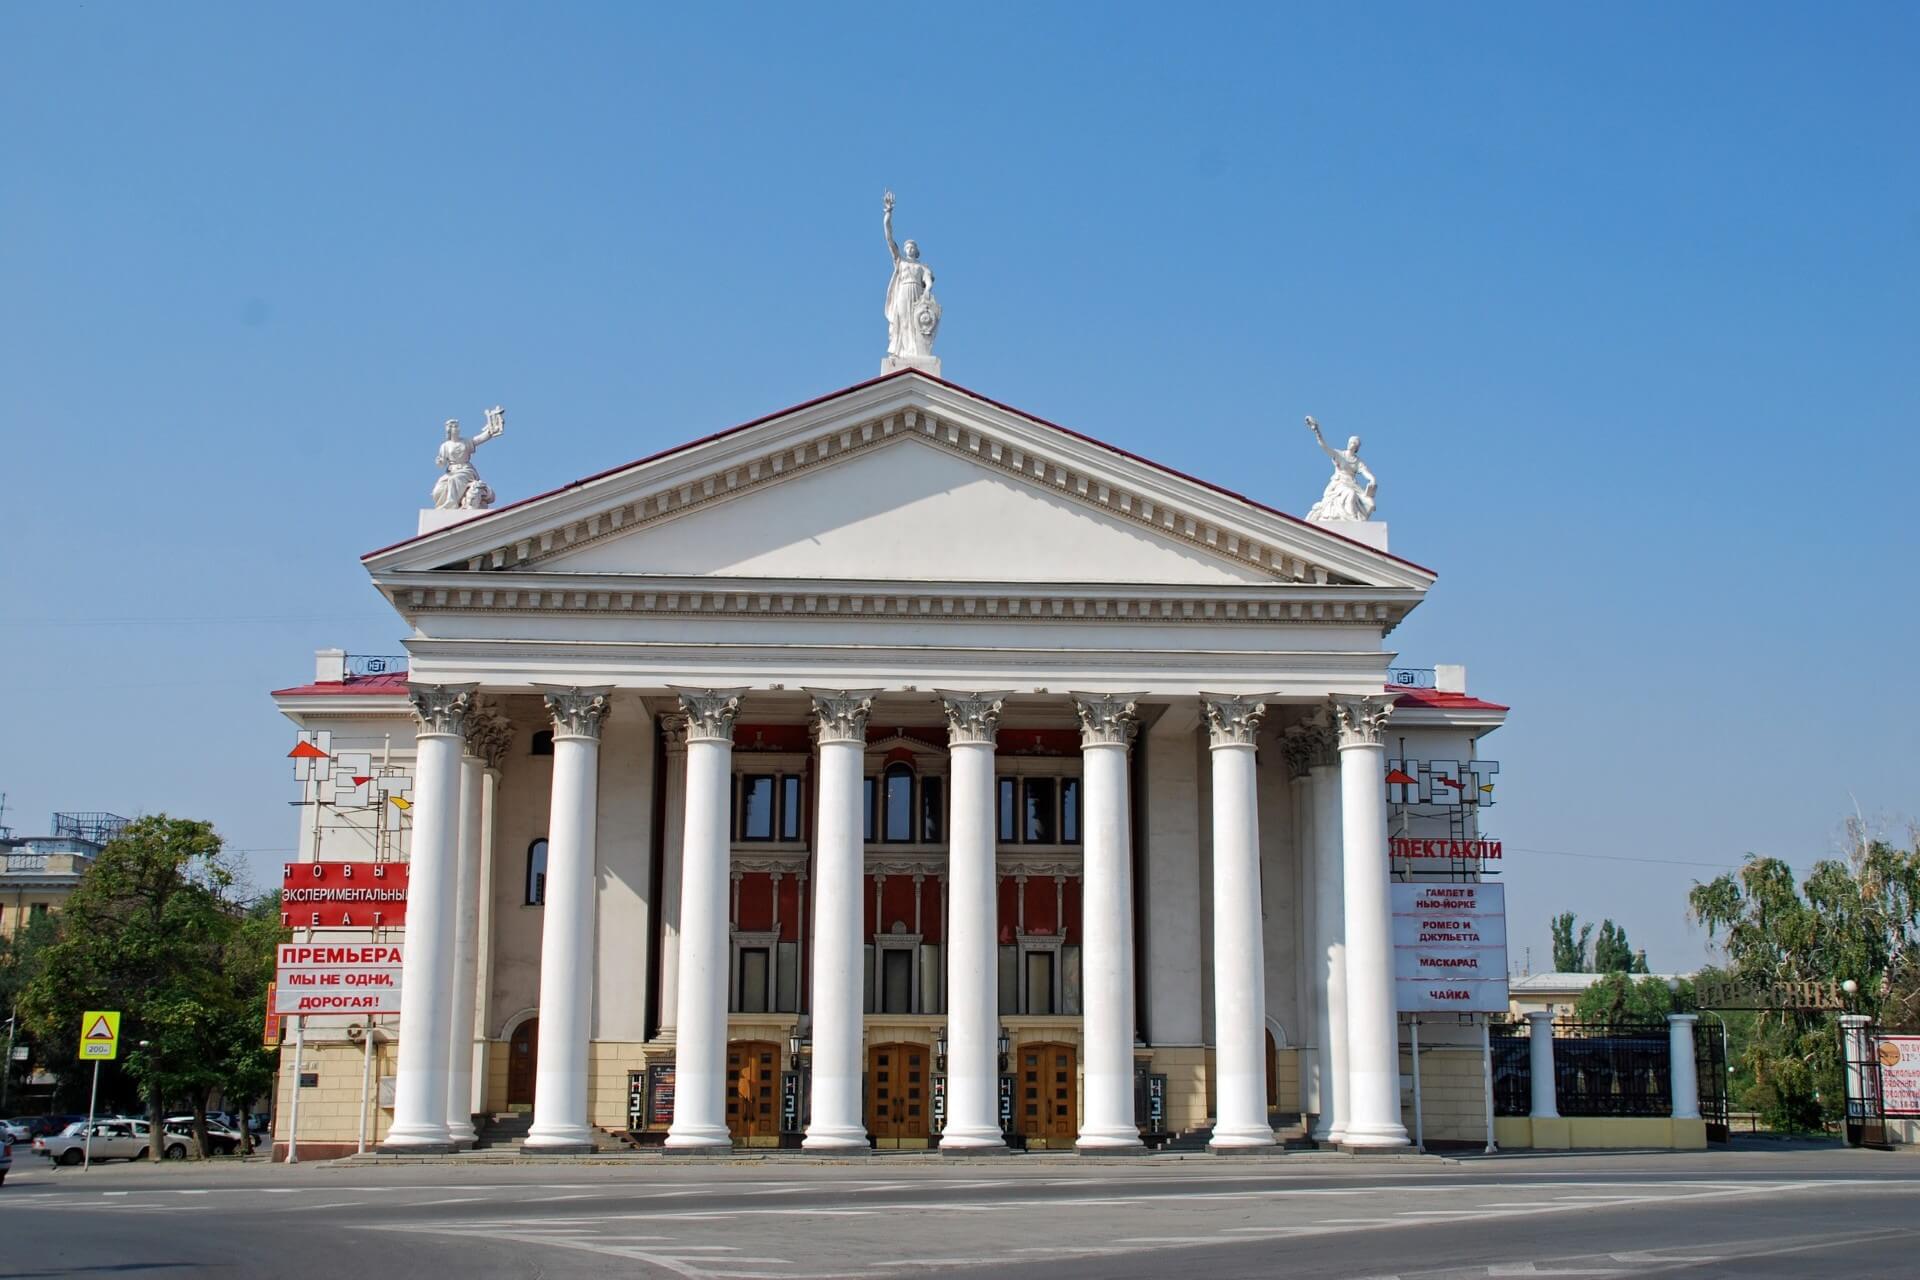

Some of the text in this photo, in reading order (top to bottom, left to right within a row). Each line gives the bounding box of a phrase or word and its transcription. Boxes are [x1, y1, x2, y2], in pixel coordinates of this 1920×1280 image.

[1426, 889, 1475, 897] ГАМЛЕТ В
[1416, 899, 1477, 909] НЬЮ-ЙОРКЕ
[1423, 921, 1471, 929] РОМЕО И
[1419, 933, 1480, 942] ДЖУЛЬЕТТА
[282, 948, 402, 963] ПРЕМЬЕРА
[1420, 958, 1478, 968] МАСКАРАД
[289, 974, 394, 987] МЫ НЕ ОДНИ,
[1430, 989, 1470, 1000] ЧАЙКА
[298, 996, 380, 1009] ДОРОГАЯ!
